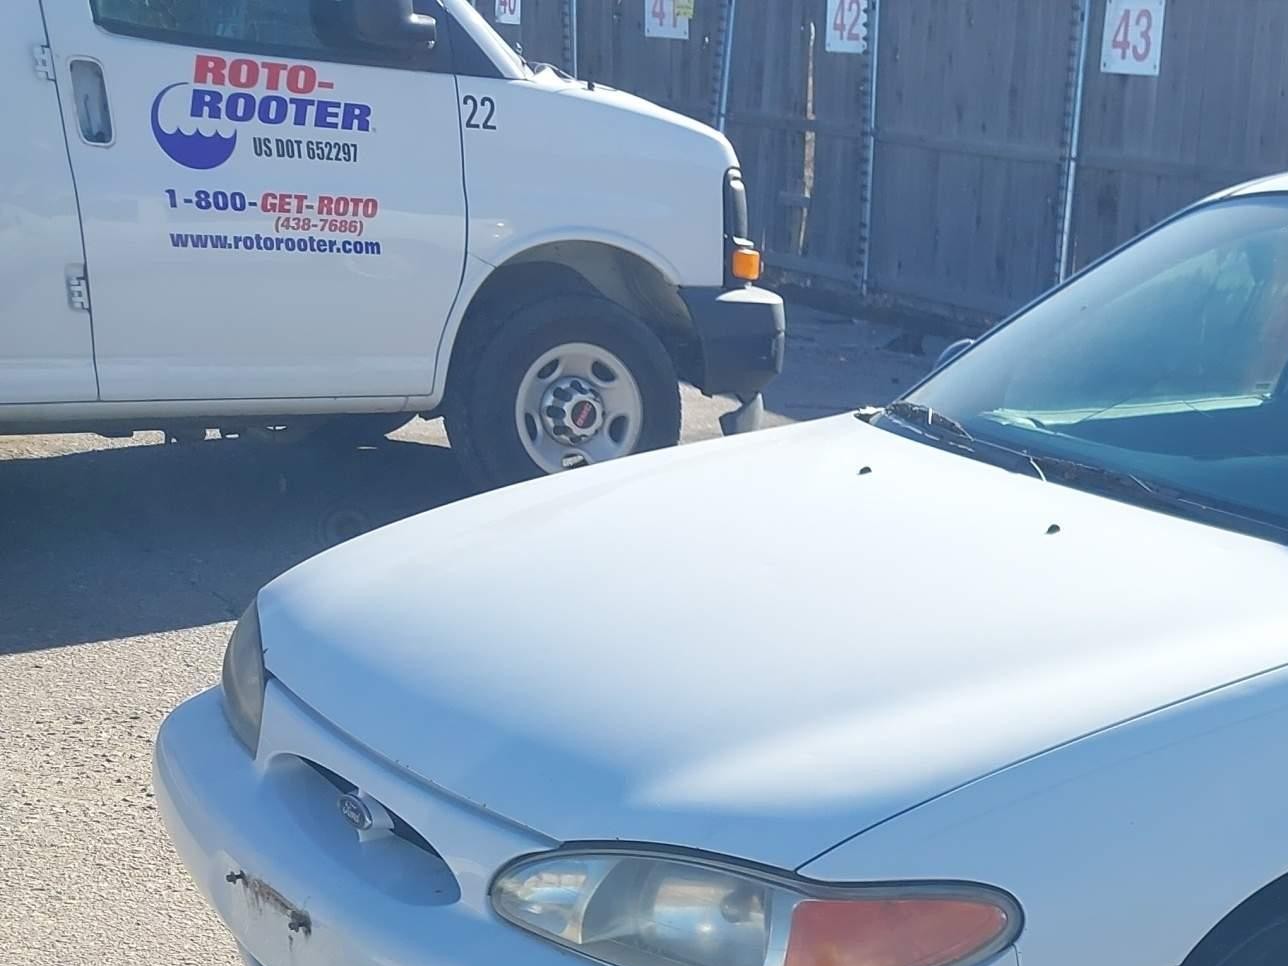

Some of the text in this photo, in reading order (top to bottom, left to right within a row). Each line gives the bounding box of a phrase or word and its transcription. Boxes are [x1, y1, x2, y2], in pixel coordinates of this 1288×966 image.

[833, 0, 860, 42] 42
[1112, 8, 1152, 62] 43
[193, 54, 334, 95] ROTO-
[190, 88, 372, 132] ROOTER
[462, 94, 497, 130] 22
[253, 136, 358, 163] US DOT 652297
[169, 233, 382, 255] www.rotorooter.com
[275, 216, 364, 236] (438-7686)
